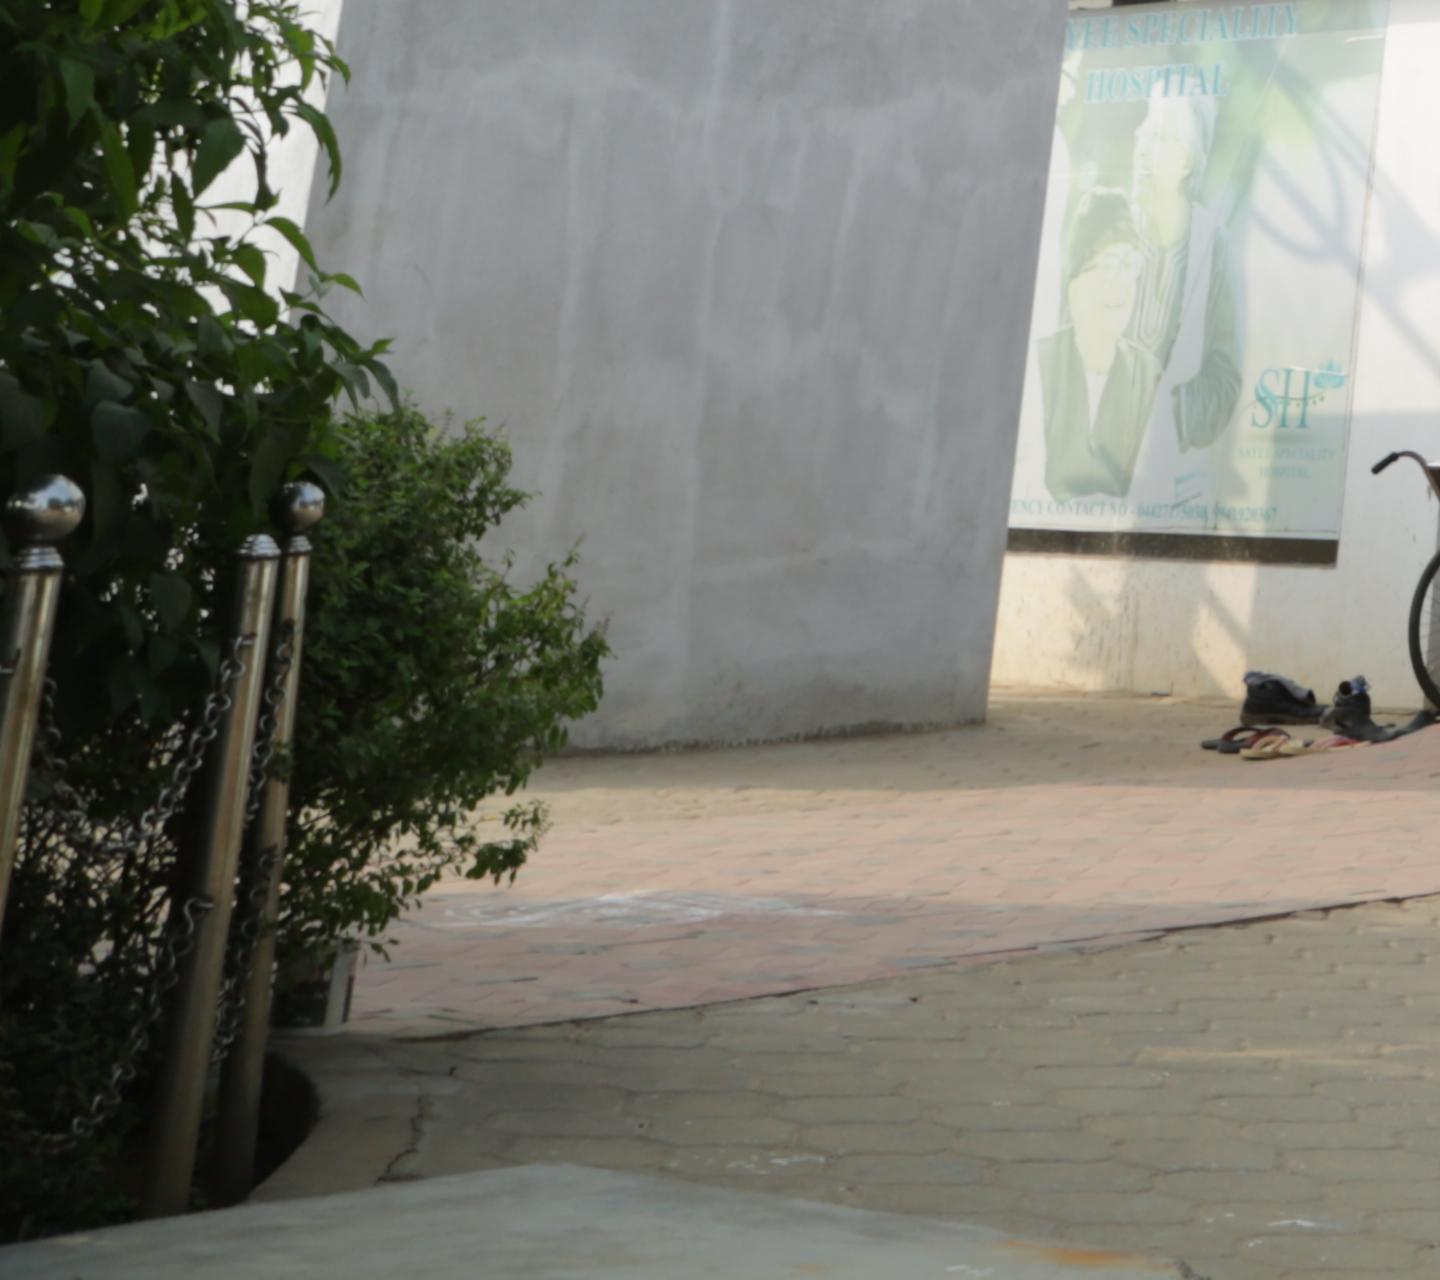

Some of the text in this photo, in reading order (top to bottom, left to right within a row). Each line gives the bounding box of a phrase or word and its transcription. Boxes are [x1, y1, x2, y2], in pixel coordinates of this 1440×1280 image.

[1125, 2, 1299, 49] SPECIALITY
[1084, 63, 1231, 105] HOSPITAL
[1250, 366, 1314, 431] SH
